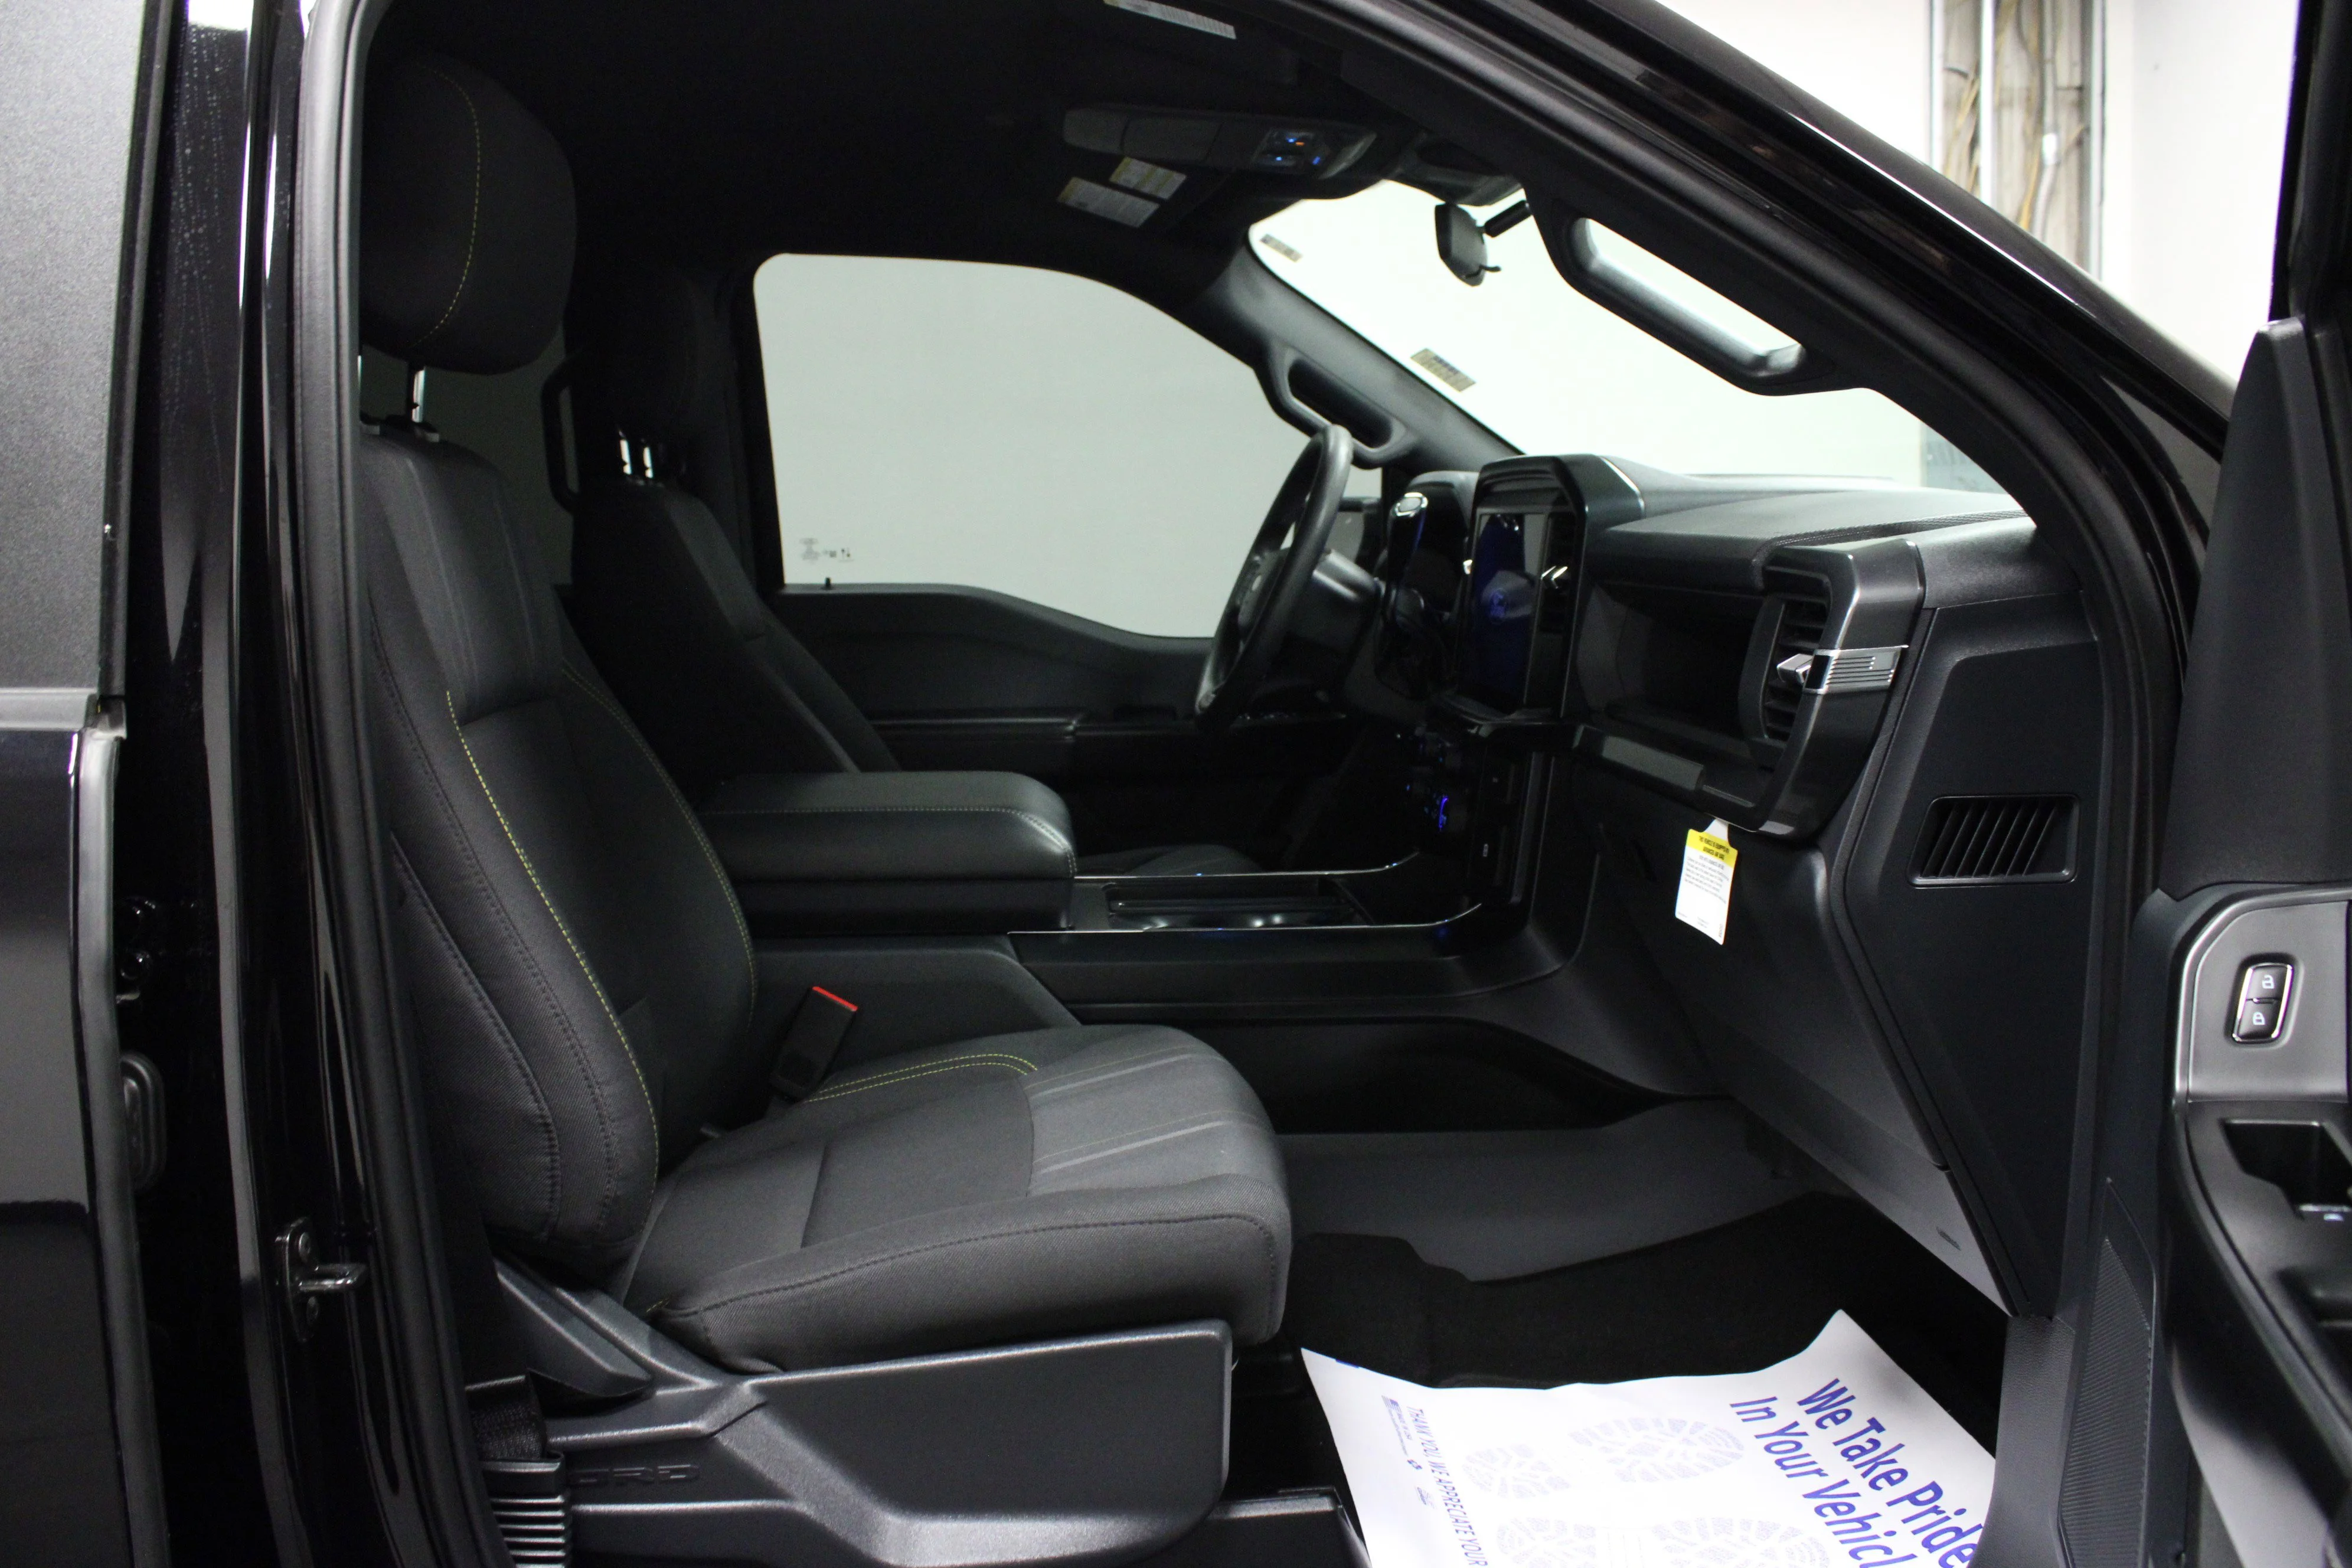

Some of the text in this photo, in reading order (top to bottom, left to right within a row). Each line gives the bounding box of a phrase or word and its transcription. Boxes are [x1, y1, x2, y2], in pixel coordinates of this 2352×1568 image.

[1406, 1406, 1433, 1438] THANK
[1427, 1461, 1449, 1476] WE
[1730, 1396, 1917, 1568] In Your Vehicl
[1797, 1378, 1983, 1568] We Take Pride
[1433, 1476, 1475, 1536] APPRECIATE
[1459, 1538, 1488, 1566] YOUR
